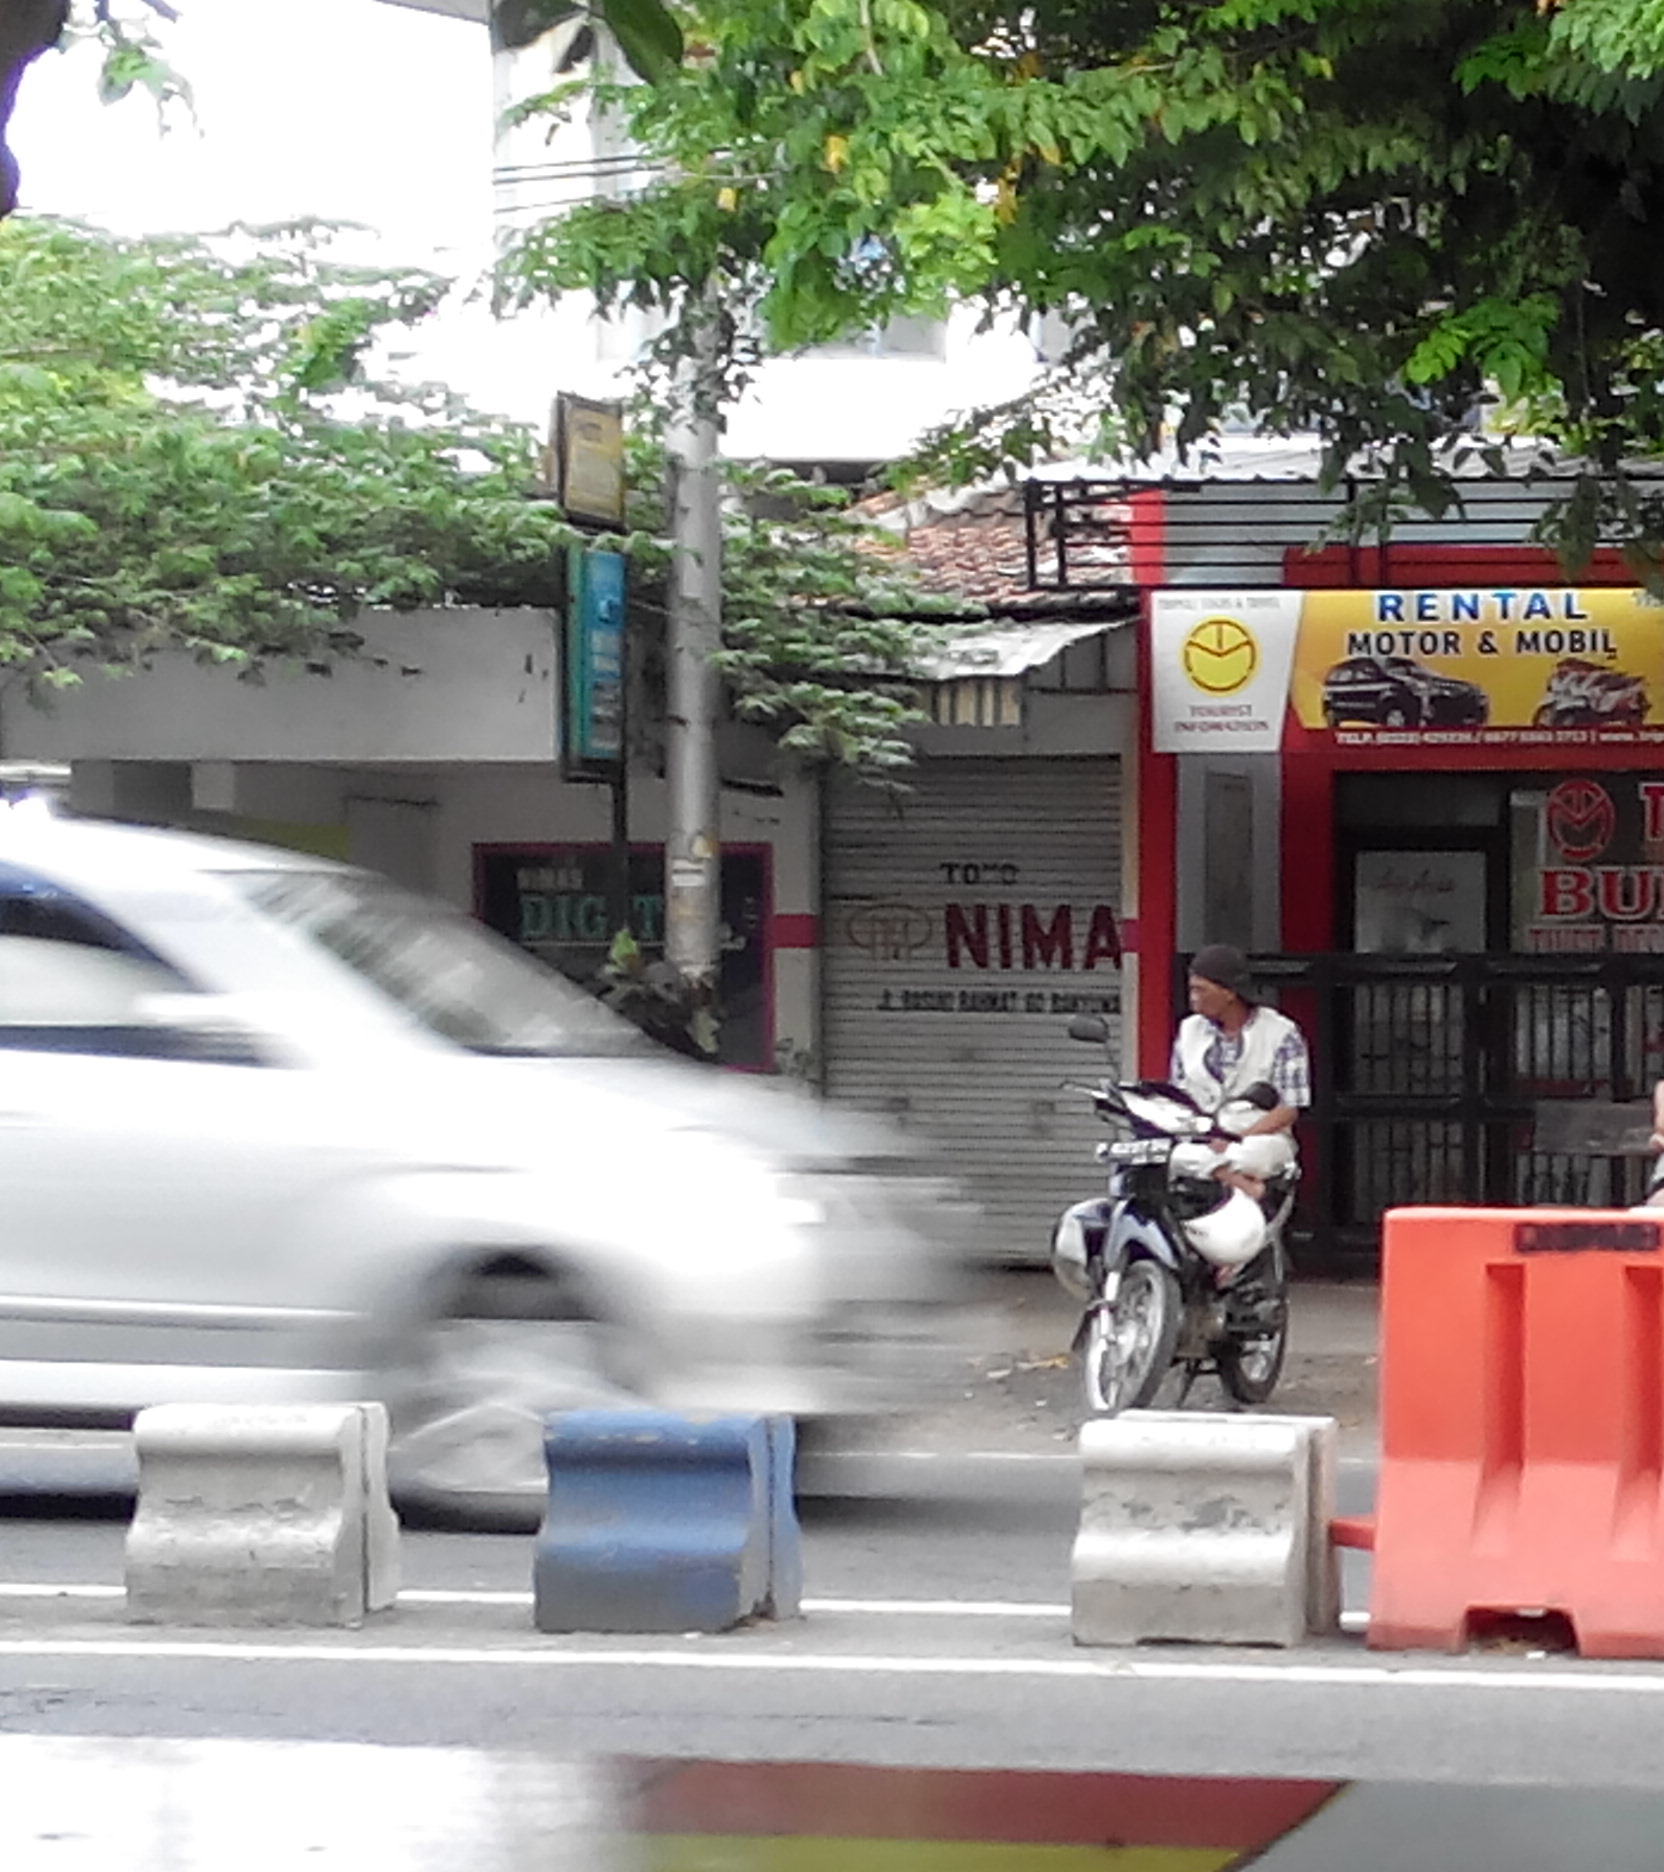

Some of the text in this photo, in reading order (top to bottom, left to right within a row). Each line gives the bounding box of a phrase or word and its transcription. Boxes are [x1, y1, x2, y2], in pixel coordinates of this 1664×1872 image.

[1377, 592, 1589, 622] RENTAL
[1347, 629, 1617, 656] MOTOR & MOBIL
[945, 903, 1122, 969] NIMA
